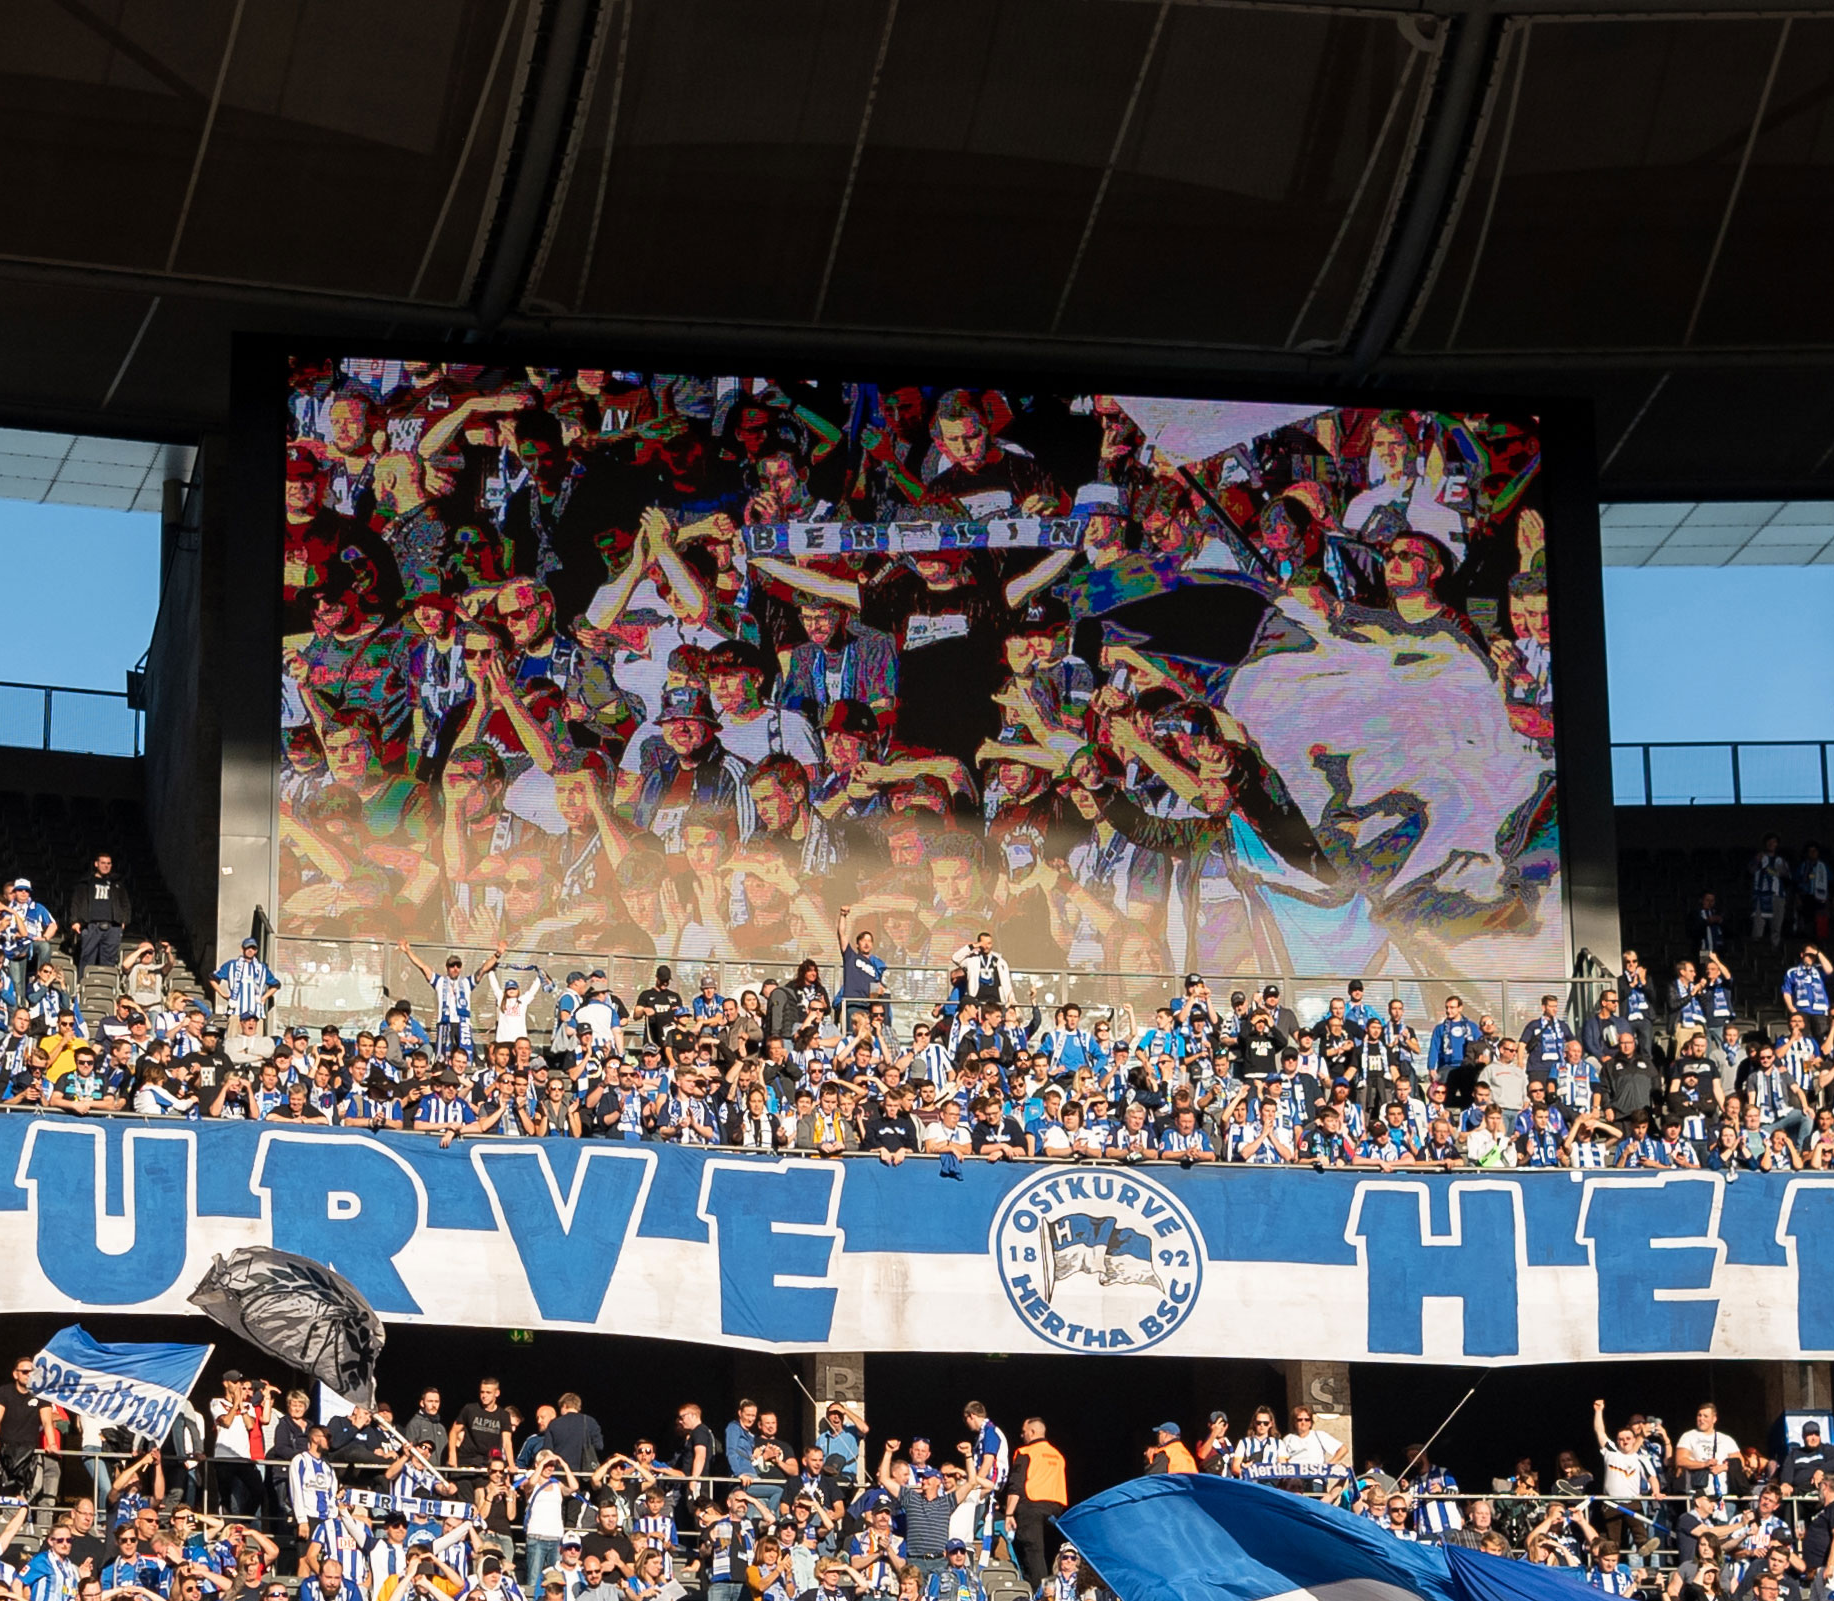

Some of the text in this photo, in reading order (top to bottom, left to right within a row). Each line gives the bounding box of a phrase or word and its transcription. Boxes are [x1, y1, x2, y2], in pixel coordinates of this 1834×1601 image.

[1013, 1177, 1183, 1240] OSTKURVE
[1010, 1246, 1190, 1268] 18 92
[1011, 1276, 1191, 1350] HERTHA BSC
[1249, 1465, 1327, 1478] Hertha BSC
